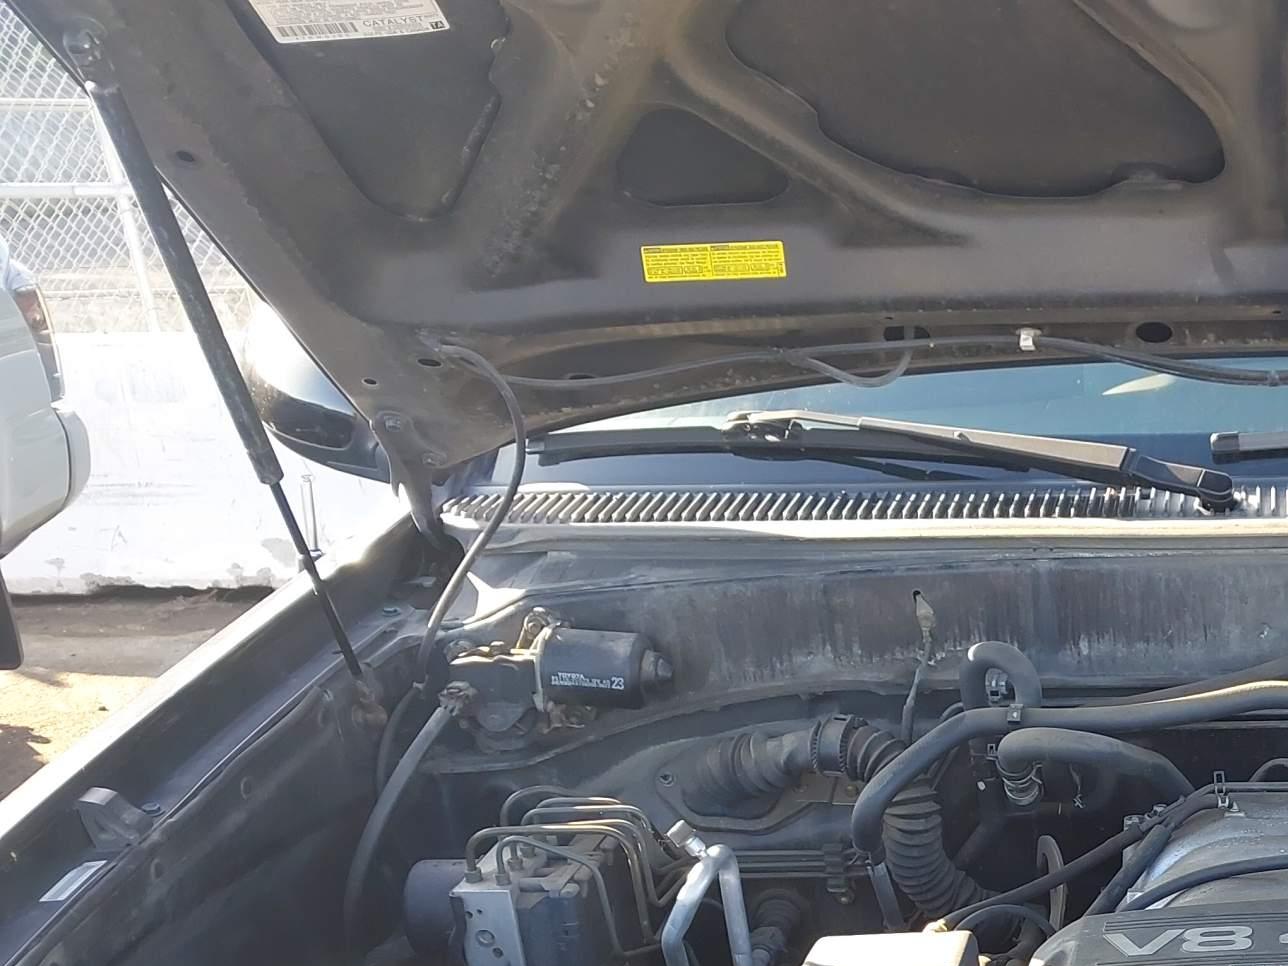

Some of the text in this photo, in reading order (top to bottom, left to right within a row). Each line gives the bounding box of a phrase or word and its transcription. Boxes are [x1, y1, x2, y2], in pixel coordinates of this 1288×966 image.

[363, 16, 424, 27] CATALYST
[611, 677, 625, 690] 23
[1103, 926, 1254, 957] V8
